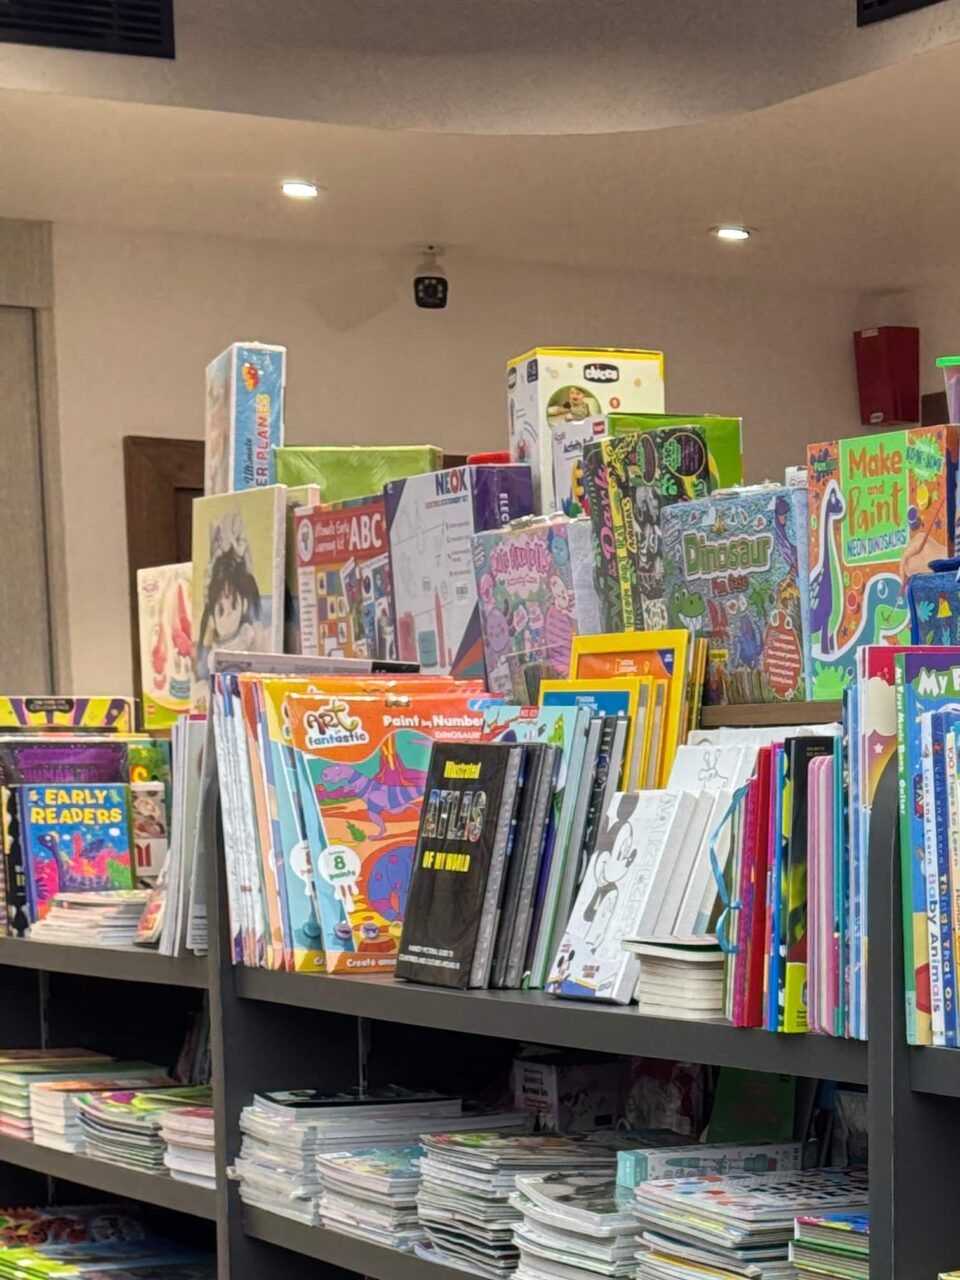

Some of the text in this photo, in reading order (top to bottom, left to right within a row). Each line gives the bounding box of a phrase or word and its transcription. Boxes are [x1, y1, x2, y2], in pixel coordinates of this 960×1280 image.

[848, 444, 902, 480] Make
[435, 467, 467, 496] NEOX
[867, 483, 885, 496] and
[848, 485, 904, 537] Paint
[349, 512, 382, 550] ABC
[684, 534, 772, 575] Dinosaur
[917, 671, 948, 698] My
[383, 715, 419, 728] Paint
[308, 733, 366, 748] fantastic
[444, 760, 481, 779] Illustrated
[45, 788, 107, 805] EARLY
[30, 807, 122, 825] READERS
[421, 789, 487, 843] ATLAS
[334, 855, 346, 871] 8
[926, 873, 941, 1013] Baby Animals
